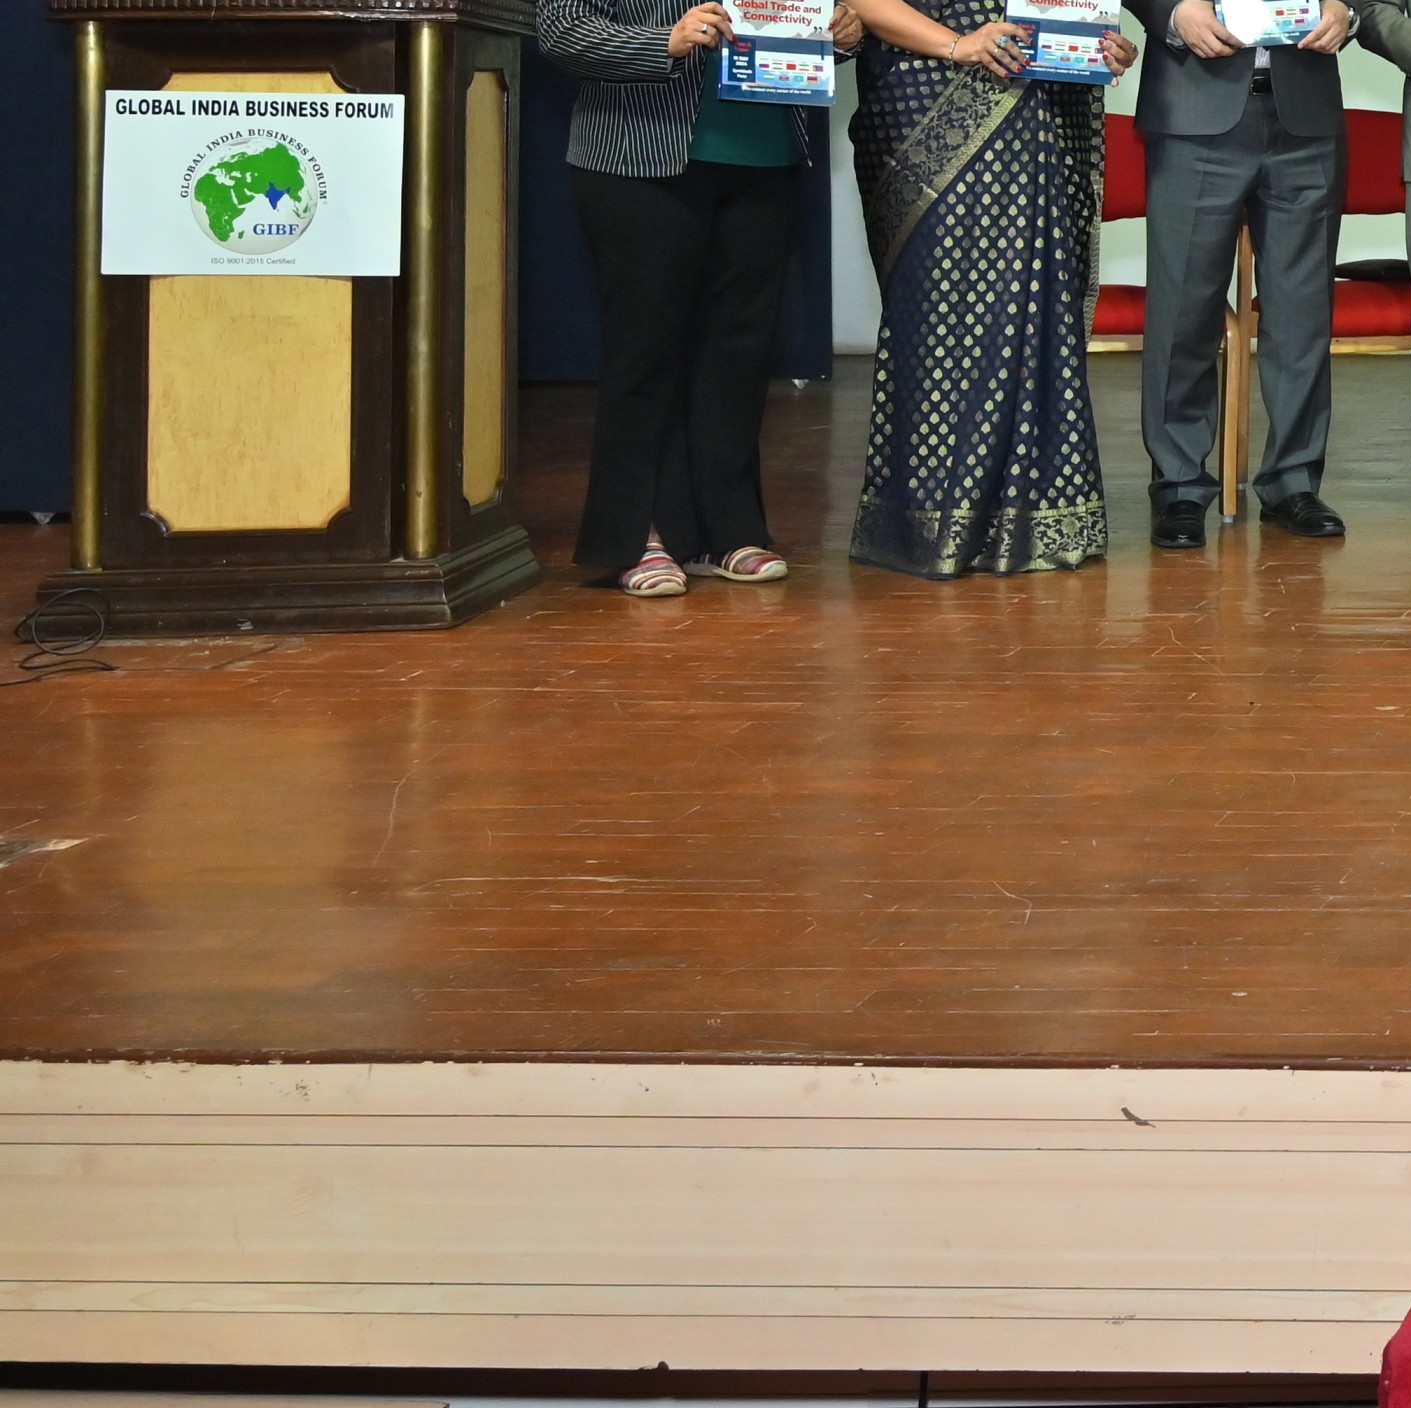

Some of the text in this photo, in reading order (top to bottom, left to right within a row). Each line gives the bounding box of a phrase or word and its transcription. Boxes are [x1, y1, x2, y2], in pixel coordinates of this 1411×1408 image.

[769, 3, 801, 13] Trade
[803, 5, 821, 14] and
[744, 12, 812, 26] Connectivity
[115, 98, 394, 119] GLOBAL INDIA BUSINESS FORUM
[180, 128, 327, 200] GLOBAL INDIA BUSINESS FORUM
[253, 223, 299, 236] GIBF
